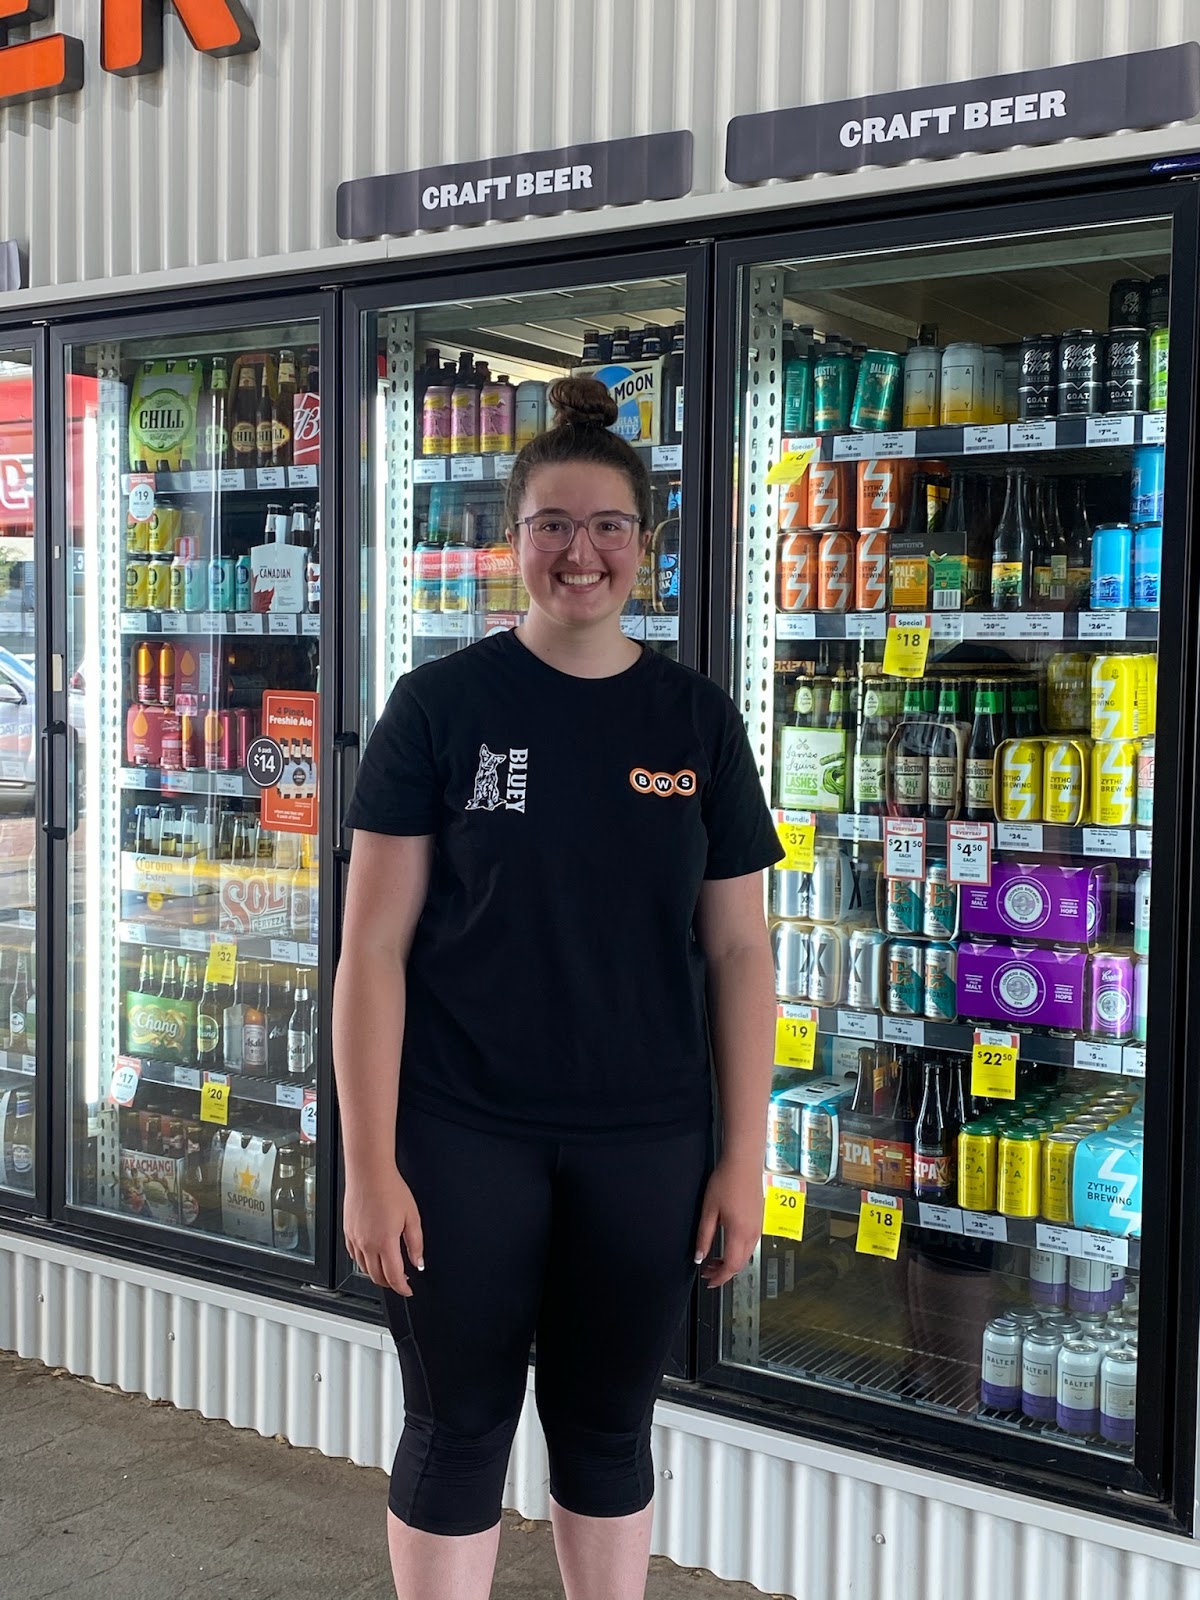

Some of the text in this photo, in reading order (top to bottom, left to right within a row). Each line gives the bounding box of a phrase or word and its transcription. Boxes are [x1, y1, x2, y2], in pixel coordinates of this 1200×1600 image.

[839, 89, 1067, 148] CRAFT BEER
[422, 164, 593, 210] CRAFT BEER
[614, 372, 654, 401] MOON
[139, 409, 185, 430] CHILL
[618, 415, 639, 425] GIAN
[613, 425, 639, 435] HITE
[134, 490, 149, 501] $19
[259, 568, 291, 579] CANADIAN
[659, 570, 673, 581] ILD
[894, 565, 915, 577] PALE
[893, 576, 910, 589] ALE
[897, 618, 923, 628] Special
[896, 632, 921, 648] $18
[276, 707, 305, 717] 4 Pines
[269, 715, 313, 727] Freshie Ale
[785, 744, 818, 759] James
[253, 754, 276, 774] $14
[785, 758, 818, 771] Squire
[904, 763, 924, 773] BOSTON
[936, 764, 957, 774] BOSTON
[505, 748, 528, 813] BLUEY
[784, 775, 818, 790] LASHES
[904, 780, 919, 788] PALE
[937, 781, 951, 789] PALE
[1050, 776, 1072, 784] ZYTHO
[1101, 778, 1123, 786] ZYTHO
[906, 787, 916, 795] ALE
[938, 788, 949, 796] ALE
[974, 783, 990, 792] PALE
[1050, 784, 1081, 792] BREWING
[975, 791, 987, 799] ALE
[785, 815, 810, 823] Bundle
[785, 832, 807, 846] $37
[135, 856, 173, 873] Corona
[145, 870, 167, 882] Extra
[221, 873, 287, 933] SOL
[1060, 907, 1079, 916] HOPS
[252, 917, 286, 931] CERVEZA
[217, 952, 232, 963] $32
[965, 983, 983, 991] MALT
[1054, 993, 1074, 1001] HOPS
[786, 1010, 809, 1019] Special
[136, 1011, 178, 1039] Chang
[786, 1024, 808, 1039] $19
[1089, 1052, 1097, 1061] $5
[119, 1071, 133, 1084] $17
[207, 1086, 223, 1100] $20
[843, 1141, 873, 1167] IPA
[915, 1160, 938, 1180] IPA
[1087, 1181, 1119, 1195] ZYTHO
[226, 1191, 265, 1212] SAPPORO
[775, 1194, 797, 1209] $20
[869, 1195, 895, 1207] Special
[1087, 1191, 1133, 1207] BREWING
[869, 1210, 894, 1227] $18
[1093, 1243, 1106, 1252] $26
[986, 1355, 1016, 1367] BALTER
[1063, 1378, 1095, 1389] BALTER
